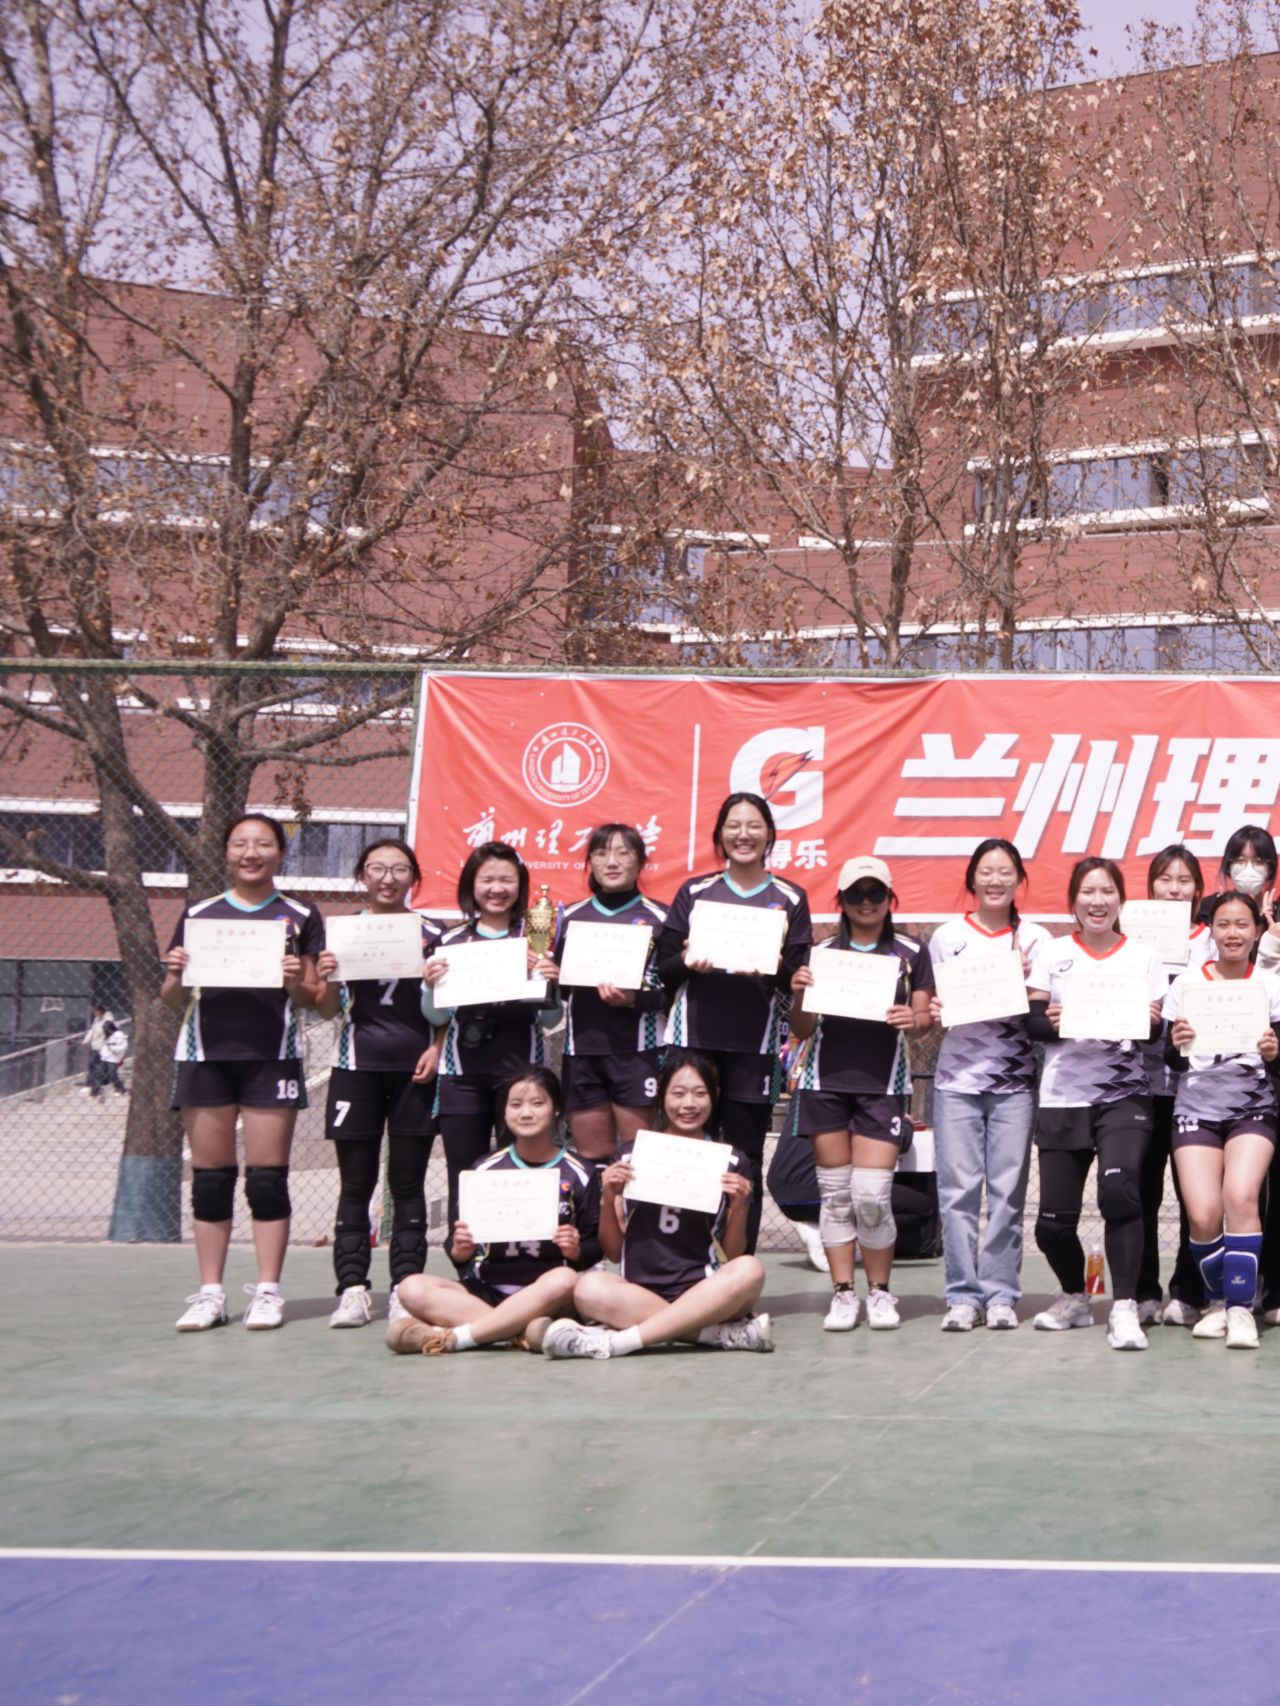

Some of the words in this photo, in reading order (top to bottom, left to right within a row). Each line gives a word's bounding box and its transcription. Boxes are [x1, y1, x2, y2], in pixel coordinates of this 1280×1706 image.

[764, 838, 828, 870] 得乐
[378, 977, 400, 1006] 7
[276, 1079, 299, 1099] 18
[644, 1077, 658, 1098] 9
[333, 1100, 352, 1127] 7
[890, 1116, 902, 1136] 3
[658, 1205, 682, 1235] 6
